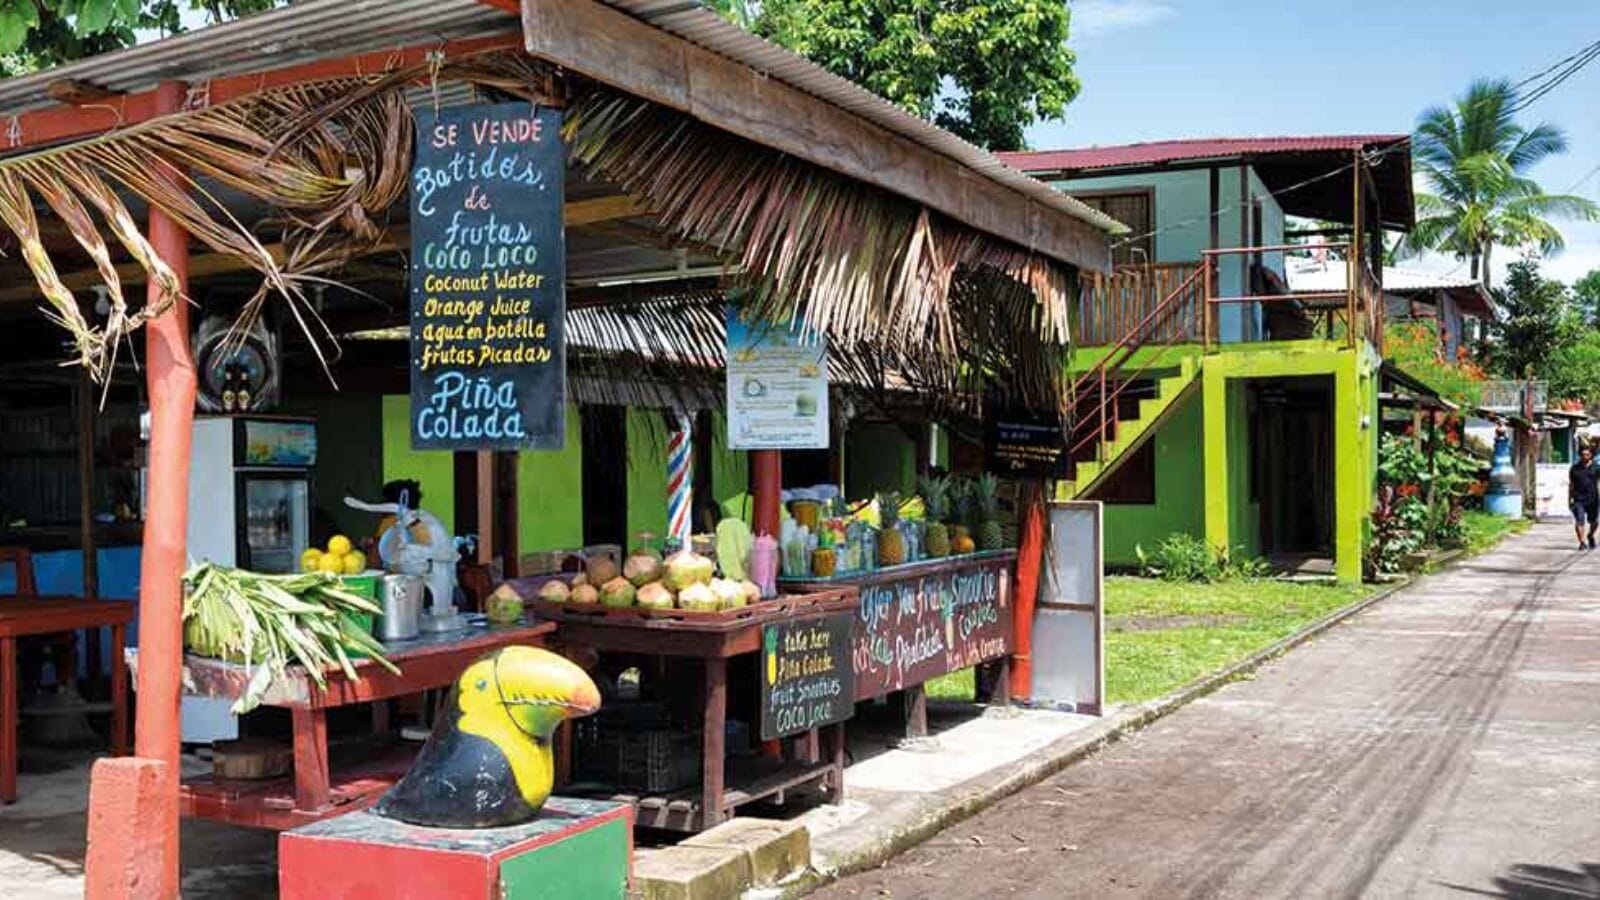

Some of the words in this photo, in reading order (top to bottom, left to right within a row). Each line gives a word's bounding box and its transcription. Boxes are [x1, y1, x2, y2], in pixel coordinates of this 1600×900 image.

[432, 124, 458, 148] SE
[472, 118, 543, 145] VENDE
[464, 185, 491, 210] de
[445, 210, 532, 249] frutas
[424, 271, 489, 292] Coconut
[494, 269, 545, 289] Water
[424, 297, 484, 323] Orange
[490, 295, 531, 316] Juice
[422, 323, 464, 349] agua
[466, 327, 482, 340] en
[484, 316, 546, 343] botella
[420, 344, 475, 371] frutas
[431, 371, 517, 413] Piña
